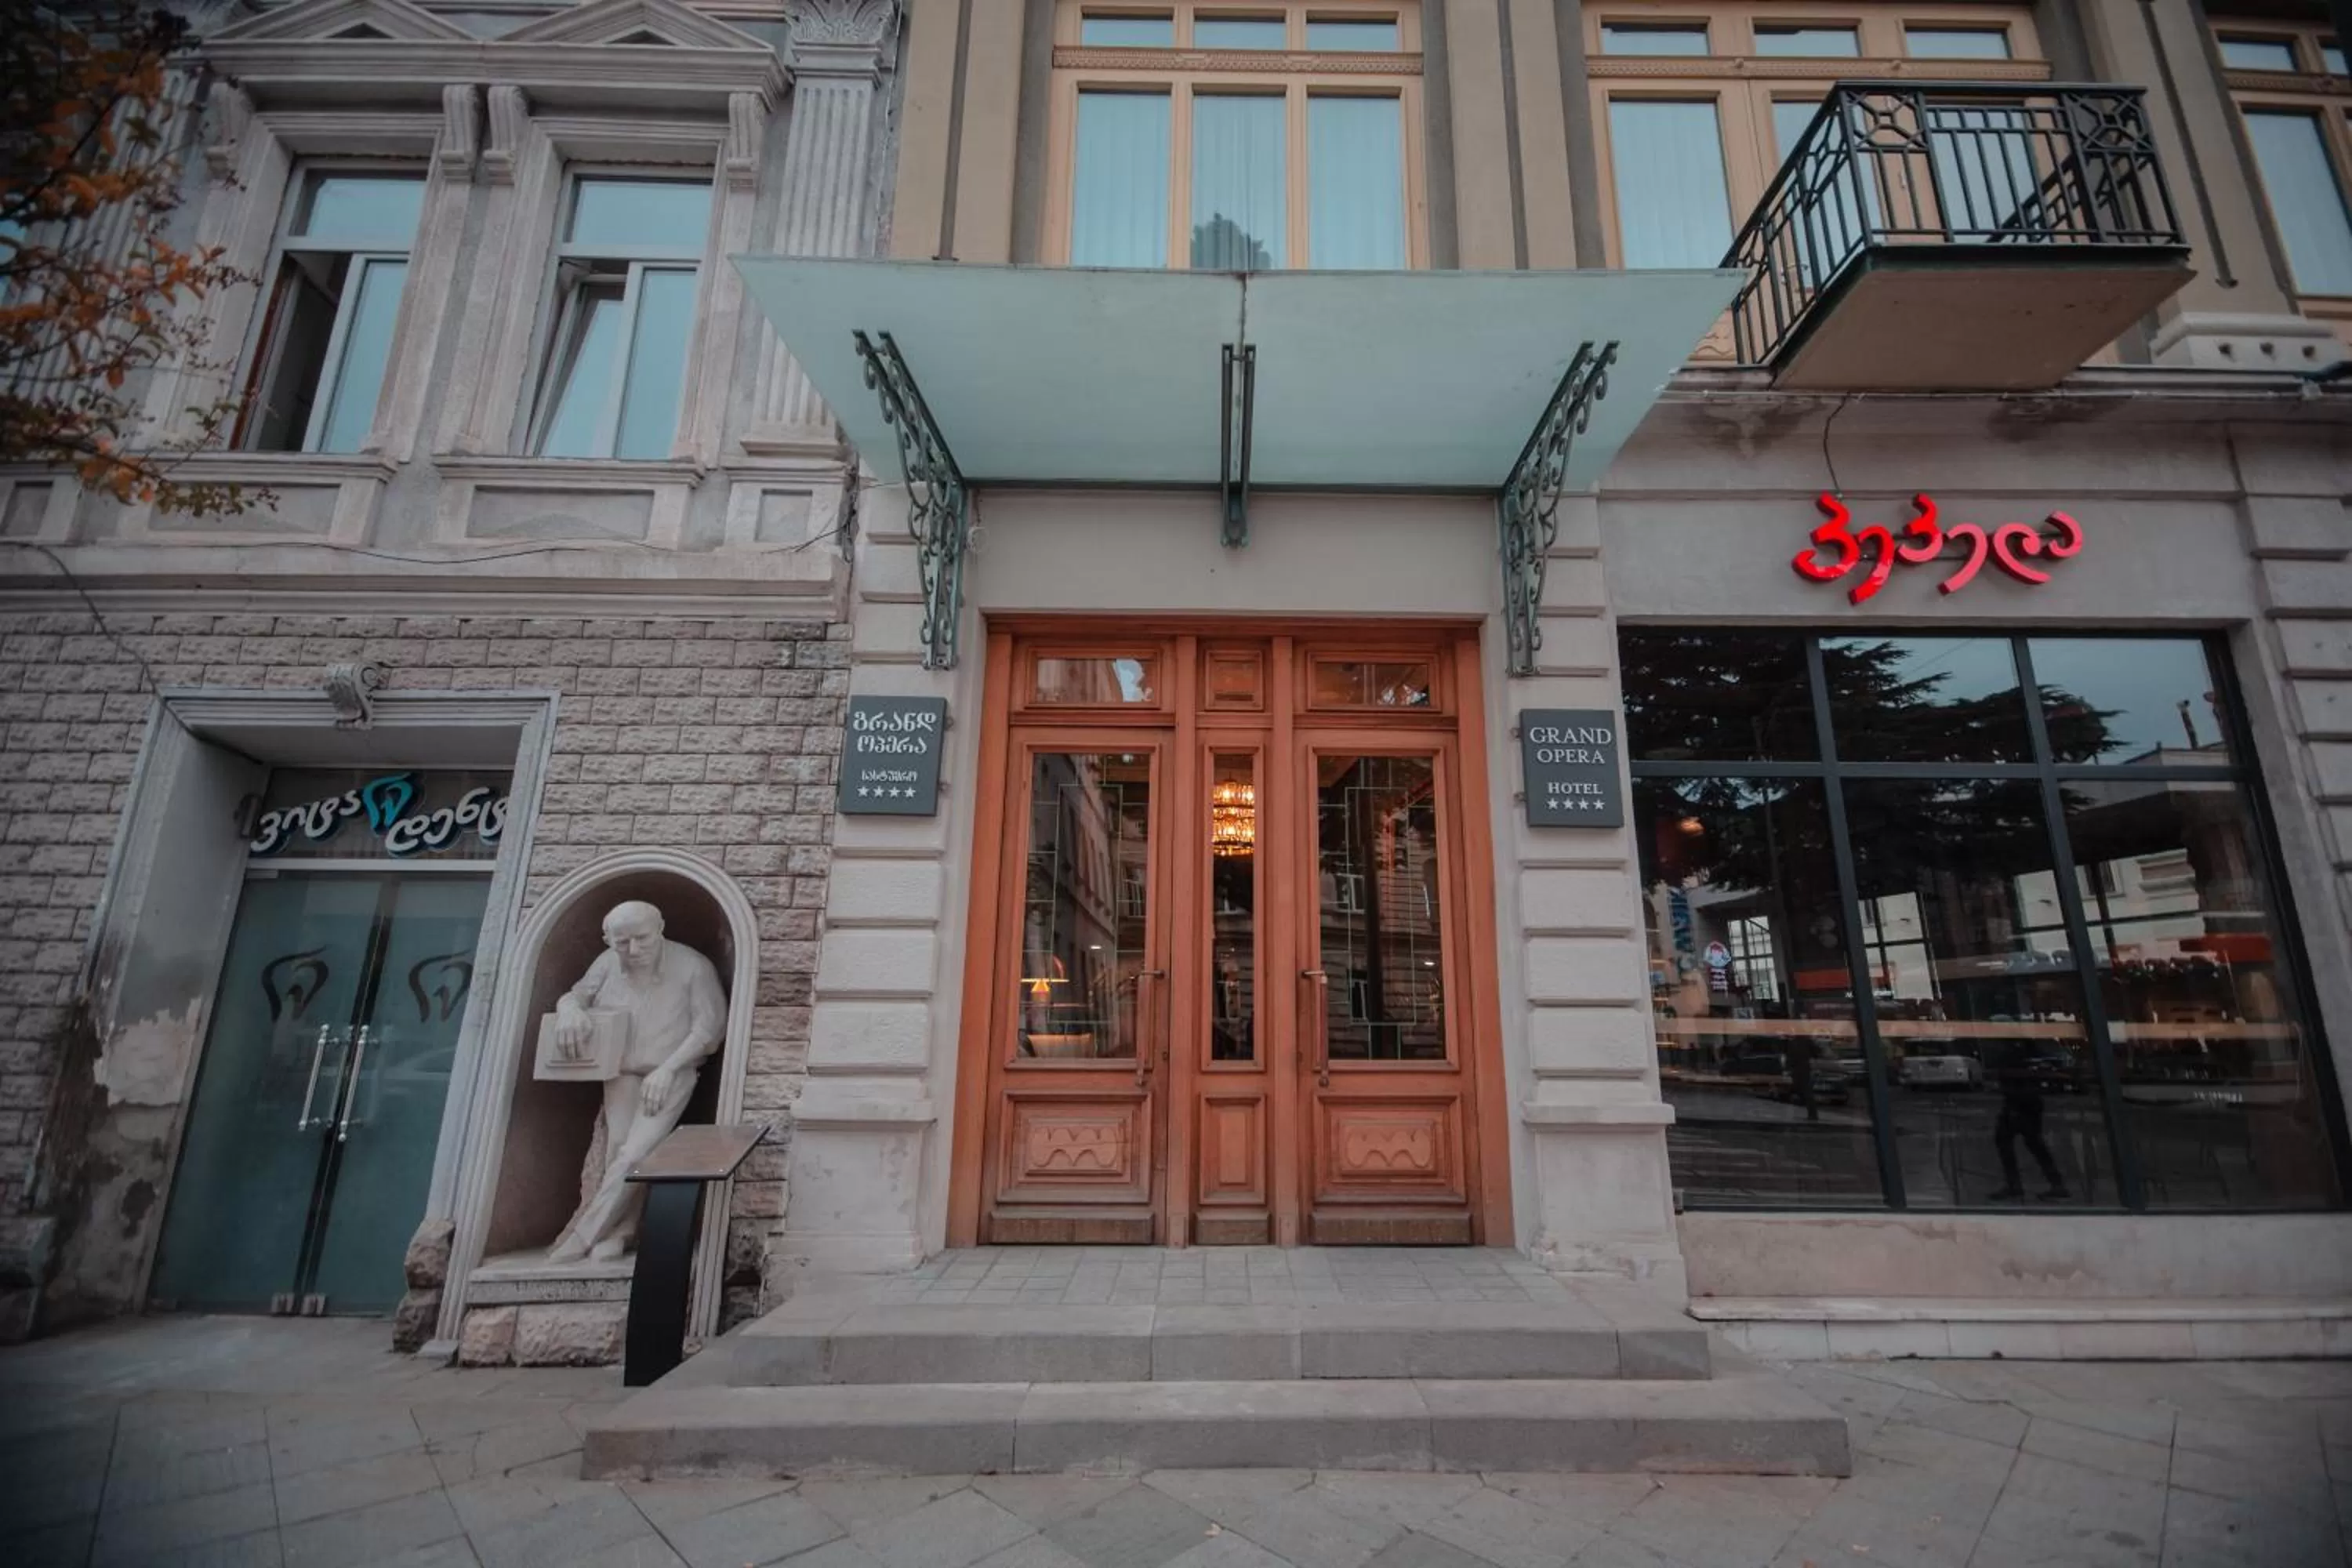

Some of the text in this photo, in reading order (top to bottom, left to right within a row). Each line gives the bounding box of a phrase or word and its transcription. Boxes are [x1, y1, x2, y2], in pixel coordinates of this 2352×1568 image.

[1791, 491, 2083, 605] პეპელა
[853, 711, 937, 731] გრანდ
[857, 735, 927, 754] ოპერა
[1530, 727, 1612, 744] GRAND
[1537, 749, 1606, 764] OPERA
[1548, 782, 1603, 794] HOTEL
